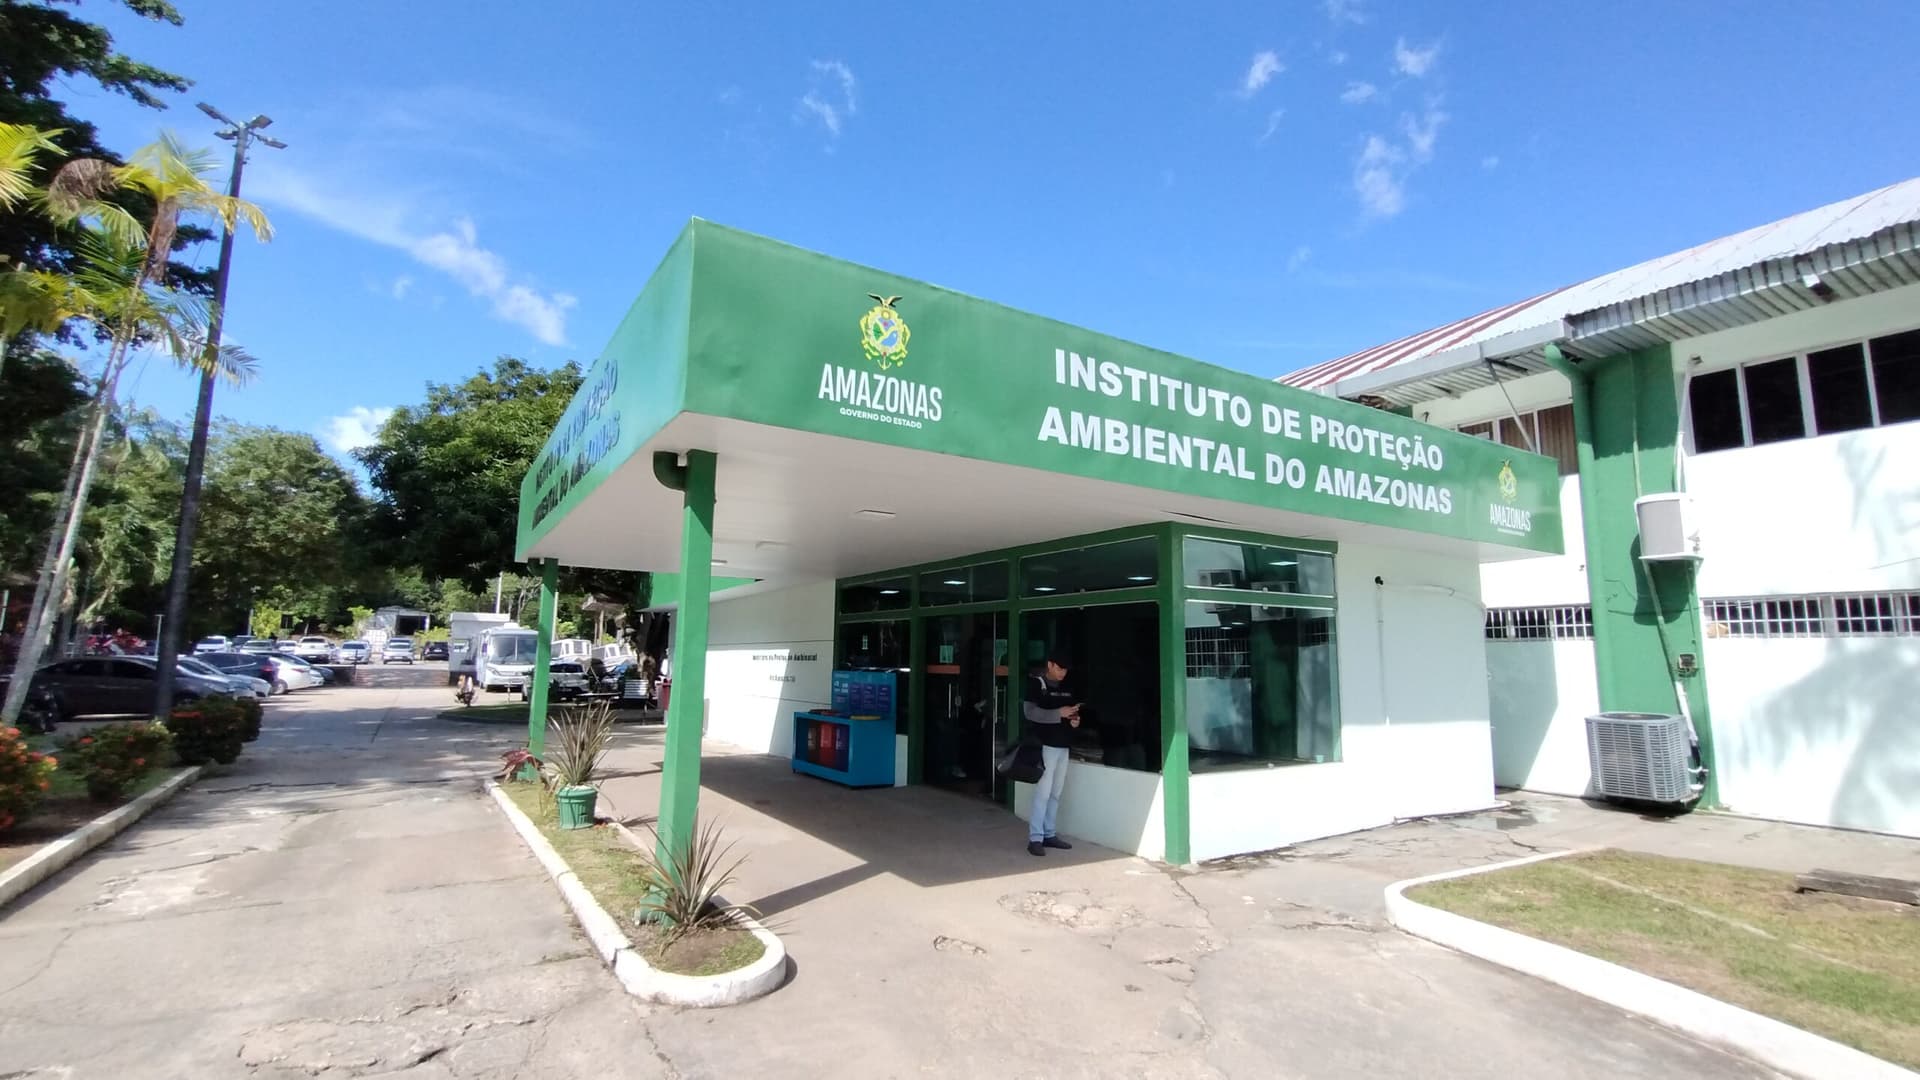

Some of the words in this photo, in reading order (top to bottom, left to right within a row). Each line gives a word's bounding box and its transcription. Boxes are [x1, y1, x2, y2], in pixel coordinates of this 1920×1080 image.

[818, 363, 942, 422] AMAZONAS
[840, 407, 879, 421] GOVERNO
[880, 414, 892, 423] DO
[893, 417, 922, 429] ESTADO
[1055, 348, 1252, 427] INSTITUTO
[1262, 403, 1302, 440] DE
[1310, 414, 1444, 471] PROTEÇÃO
[1037, 406, 1255, 480] AMBIENTAL
[1265, 452, 1306, 489] DO
[1314, 465, 1452, 514] AMAZONAS
[1490, 503, 1531, 532] AMAZONAS
